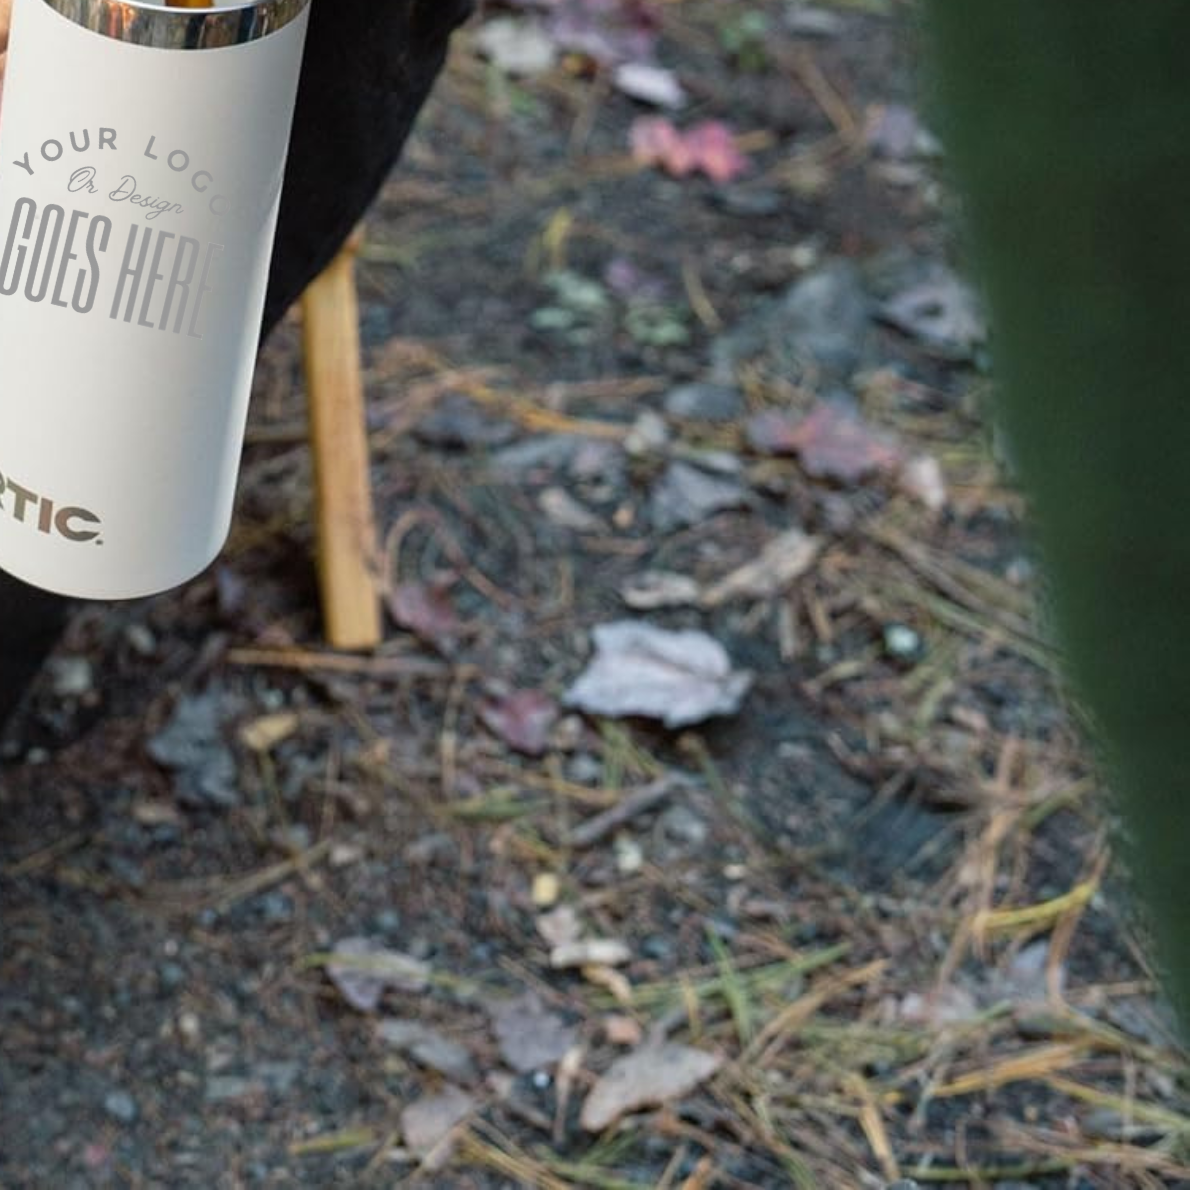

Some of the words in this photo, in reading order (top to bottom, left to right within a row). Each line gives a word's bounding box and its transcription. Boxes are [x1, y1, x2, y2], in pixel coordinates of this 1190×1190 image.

[12, 127, 118, 176] YOUR
[66, 166, 99, 194] Or
[108, 174, 184, 220] Design
[108, 222, 225, 341] HERE
